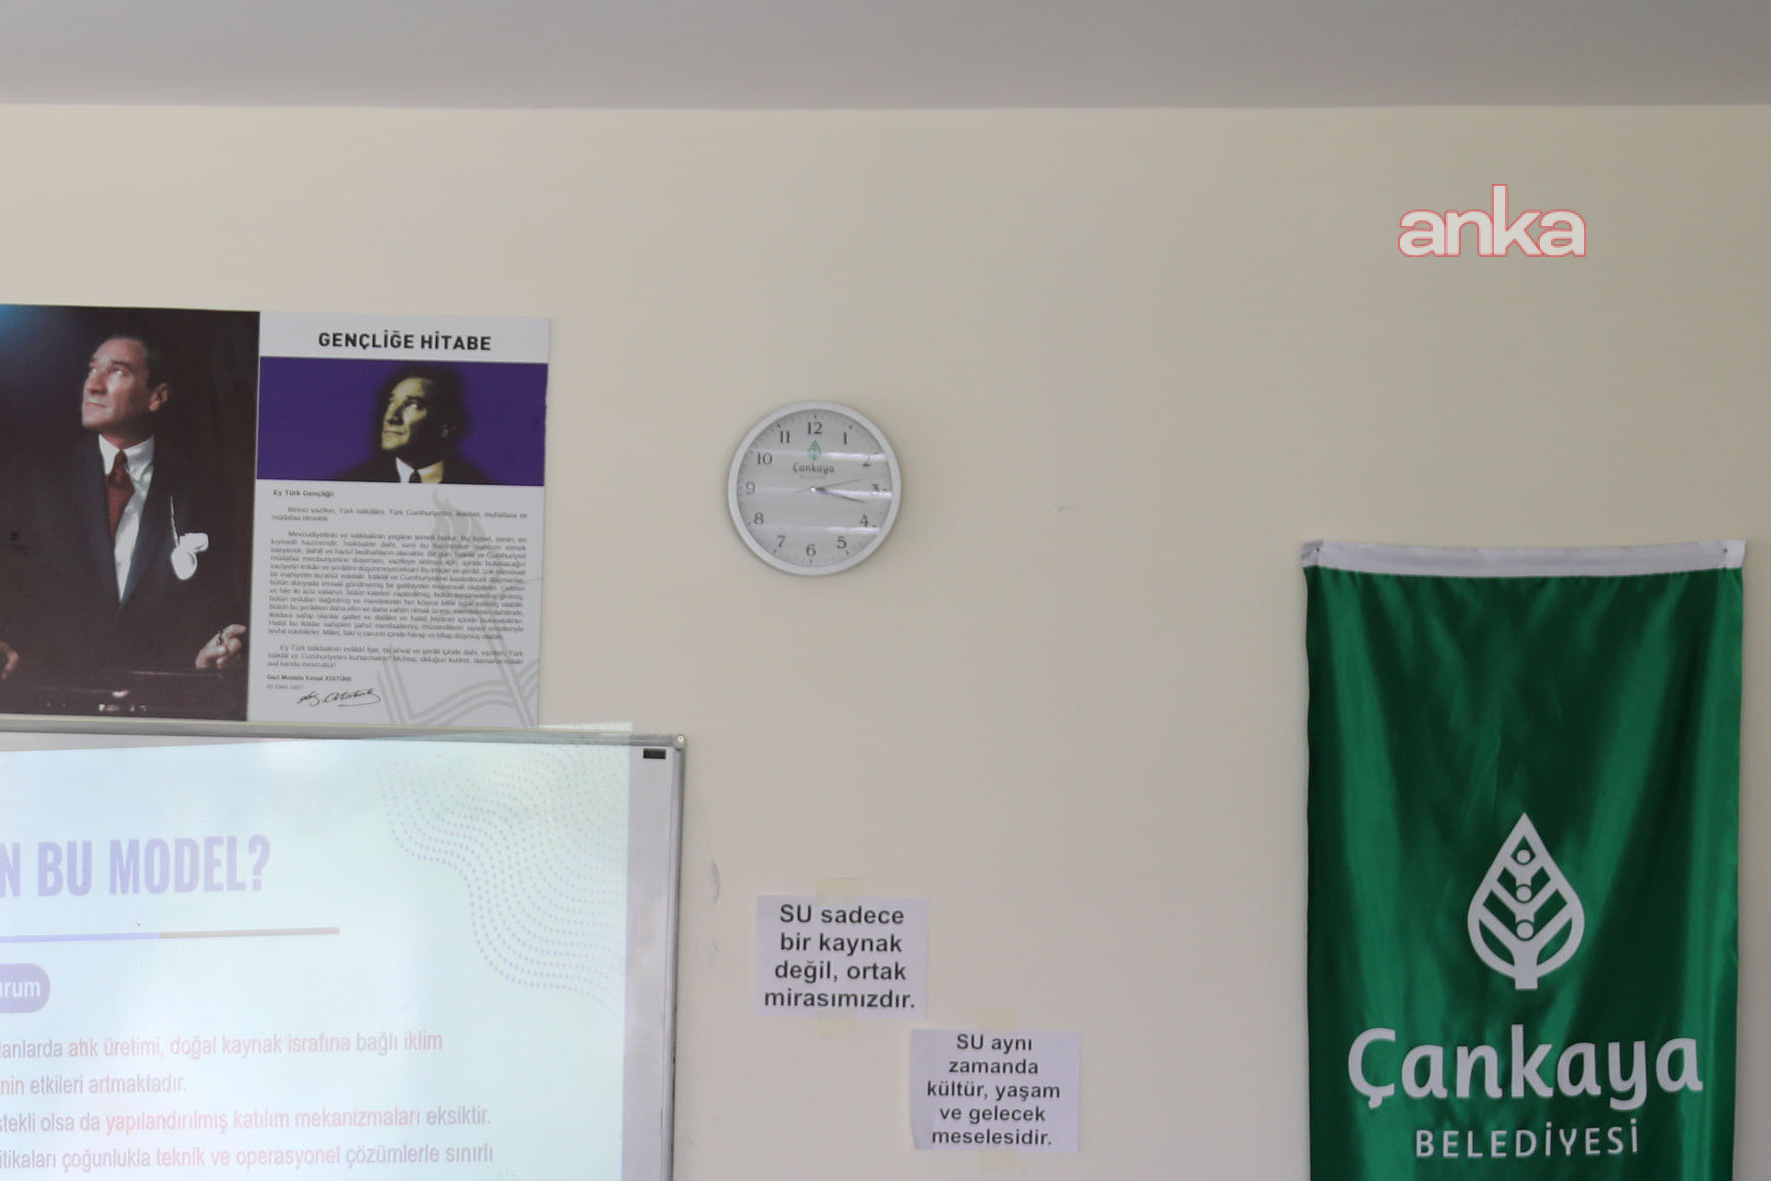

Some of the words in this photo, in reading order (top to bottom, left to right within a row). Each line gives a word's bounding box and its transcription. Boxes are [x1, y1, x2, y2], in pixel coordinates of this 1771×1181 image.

[319, 329, 415, 350] GENÇLİĞE
[420, 331, 492, 351] HİTABE
[779, 431, 791, 444] 11
[807, 421, 823, 435] 12
[842, 433, 847, 445] 1
[757, 452, 773, 465] 10
[745, 481, 756, 495] 9
[872, 484, 880, 495] 3
[754, 512, 764, 525] 8
[860, 514, 869, 527] 4
[777, 535, 786, 548] 7
[806, 543, 816, 557] 6
[837, 536, 847, 549] 5
[38, 840, 92, 897] BU
[109, 834, 270, 895] MODEL?
[780, 904, 811, 923] SU
[821, 905, 904, 924] sadece
[781, 932, 811, 951] bir
[820, 933, 902, 956] kaynak
[775, 960, 837, 984] değil,
[847, 962, 906, 980] ortak
[765, 988, 914, 1008] mirasımızdır.
[68, 1037, 99, 1058] atık
[104, 1037, 164, 1058] üretimi,
[170, 1035, 216, 1060] doğal
[222, 1034, 282, 1059] kaynak
[288, 1032, 350, 1053] israfına
[356, 1032, 397, 1056] bağlı
[404, 1030, 443, 1050] iklim
[957, 1034, 983, 1050] SU
[992, 1038, 1032, 1054] aynı
[949, 1059, 1038, 1074] zamanda
[1348, 1024, 1704, 1111] Çankaya
[30, 1074, 83, 1095] etkileri
[89, 1073, 186, 1093] artmaktadır.
[927, 1080, 987, 1099] kültür,
[996, 1086, 1060, 1101] yaşam
[40, 1112, 77, 1132] olsa
[80, 1112, 100, 1132] da
[106, 1110, 228, 1136] yapılandırılmış
[234, 1109, 290, 1128] katılım
[295, 1107, 420, 1128] mekanizmaları
[426, 1105, 491, 1126] eksiktir.
[940, 1108, 962, 1120] ve
[969, 1105, 1045, 1124] gelecek
[932, 1129, 1051, 1145] meselesidir.
[1415, 1118, 1639, 1158] BELEDİYESİ
[62, 1148, 151, 1173] çoğunlukla
[156, 1147, 205, 1168] teknik
[211, 1151, 230, 1168] ve
[236, 1145, 340, 1170] operasyonel
[346, 1144, 440, 1168] çözümlerle
[446, 1142, 493, 1163] sınırlı
